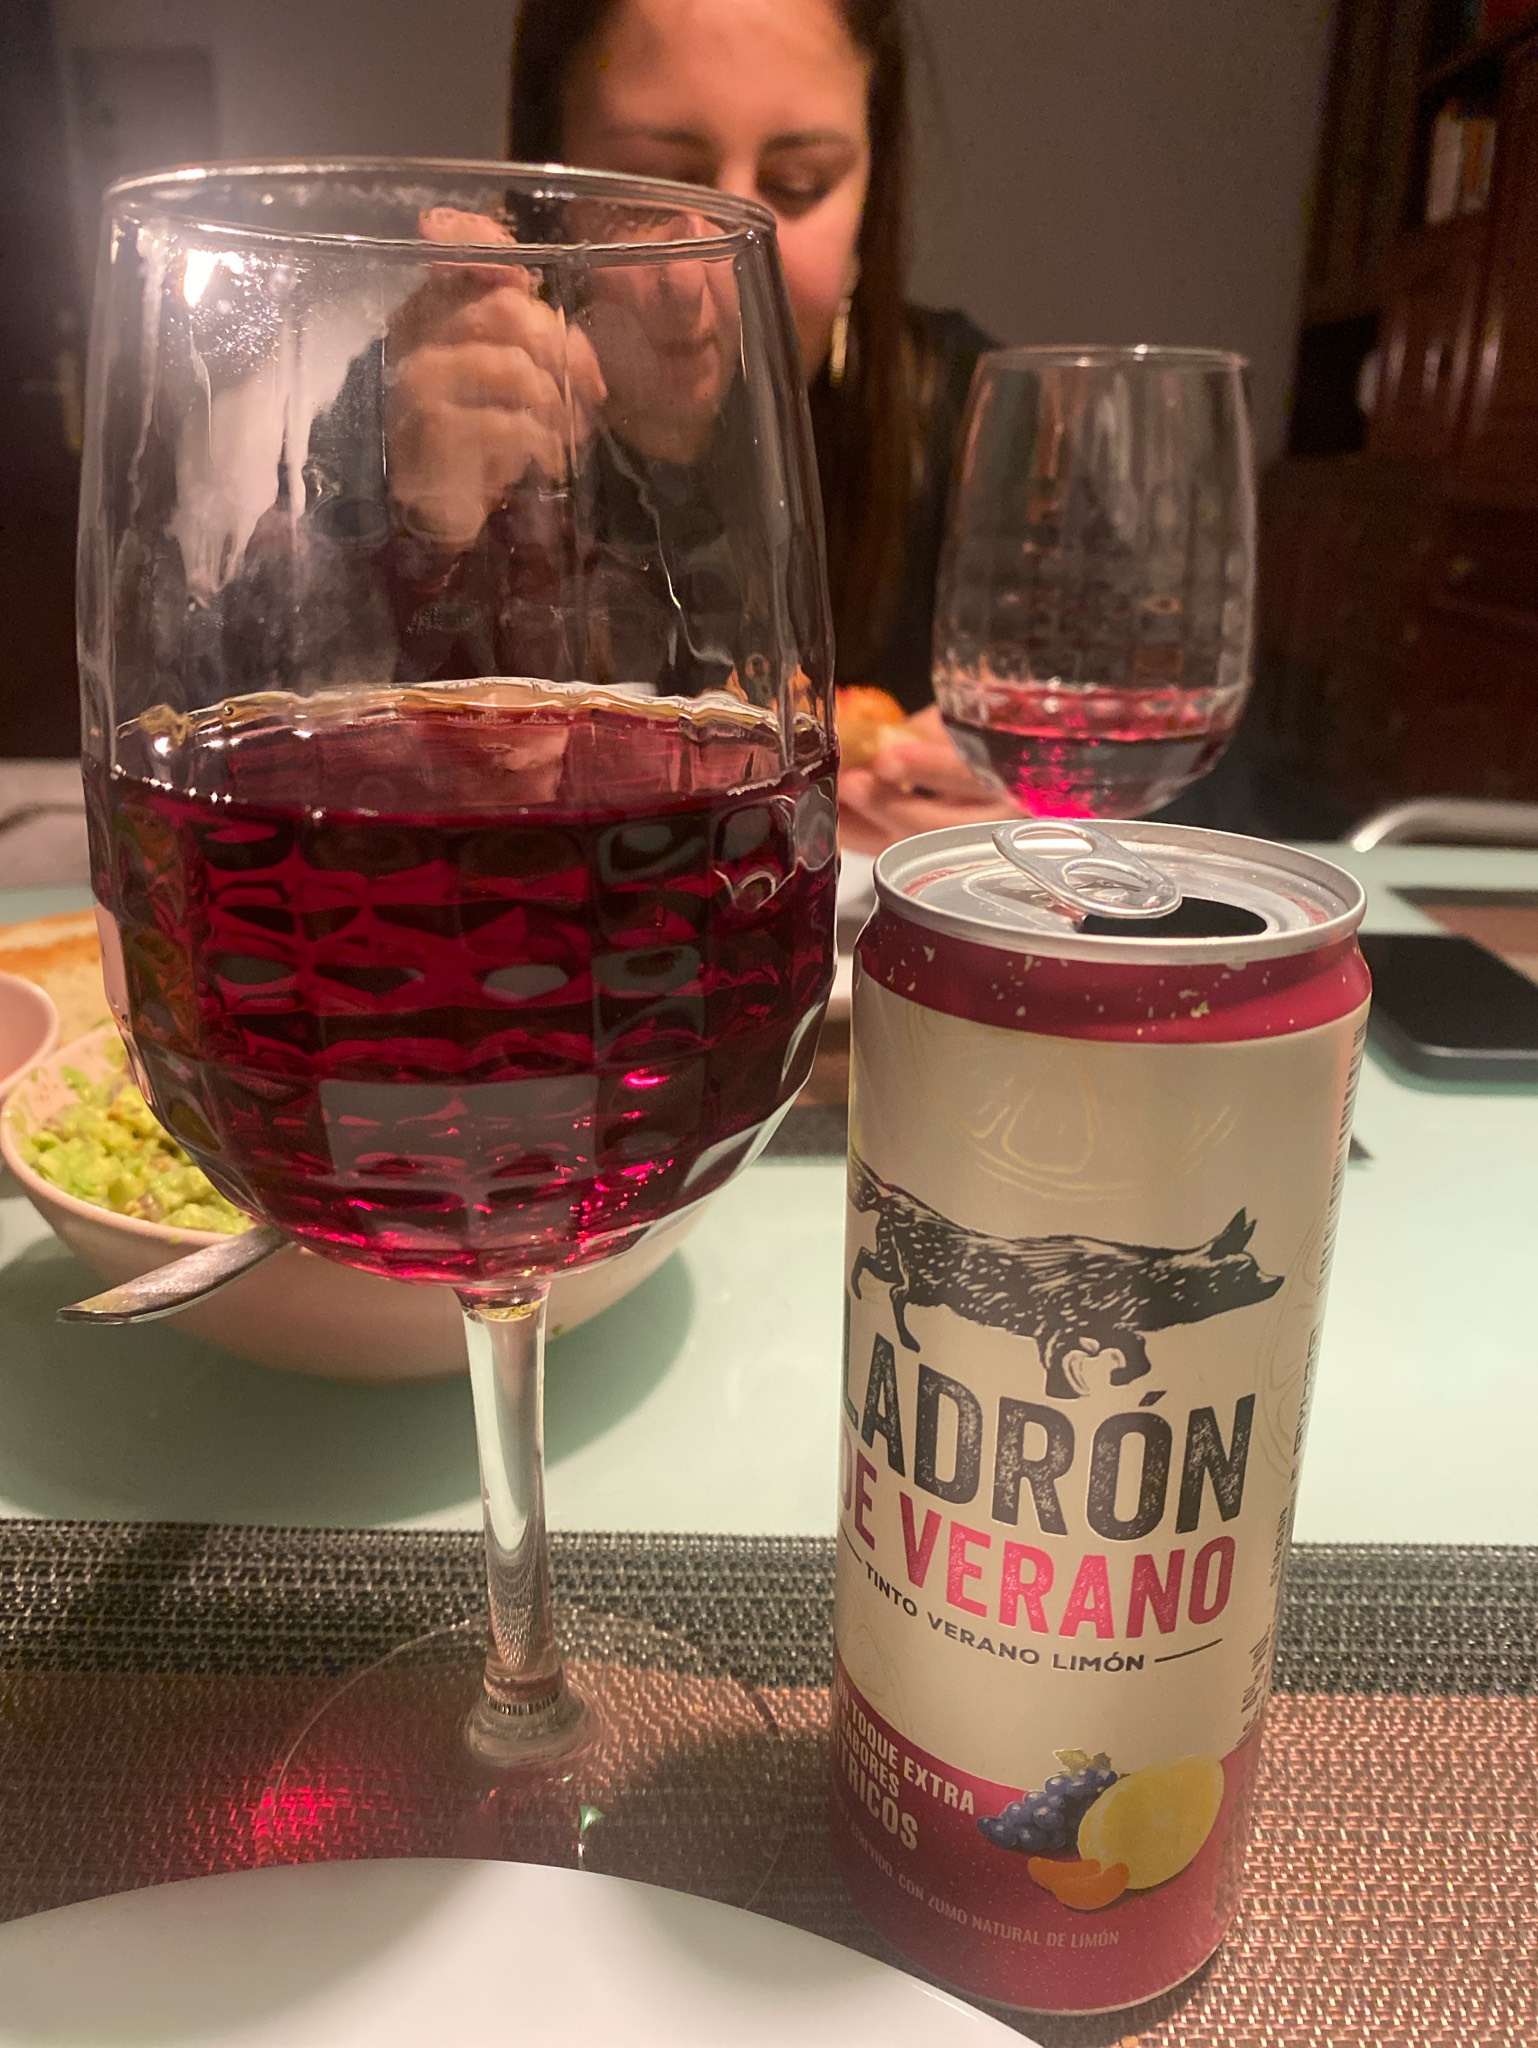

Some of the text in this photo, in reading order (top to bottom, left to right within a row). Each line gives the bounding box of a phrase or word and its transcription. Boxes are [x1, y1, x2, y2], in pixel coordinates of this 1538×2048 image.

[843, 1286, 1256, 1541] LADRÓN
[839, 1423, 877, 1550] DE
[900, 1491, 1235, 1639] VERANO
[866, 1561, 1144, 1672] TINTO VERANO LIMÓN
[841, 1708, 900, 1798] SABORES
[851, 1698, 898, 1769] TOQUE
[903, 1756, 974, 1815] EXTRA
[899, 1873, 924, 1901] CON
[927, 1896, 968, 1925] ZUMO
[971, 1914, 1041, 1945] NATURAL
[1046, 1932, 1066, 1948] DE
[1071, 1928, 1120, 1949] LIMÓN
